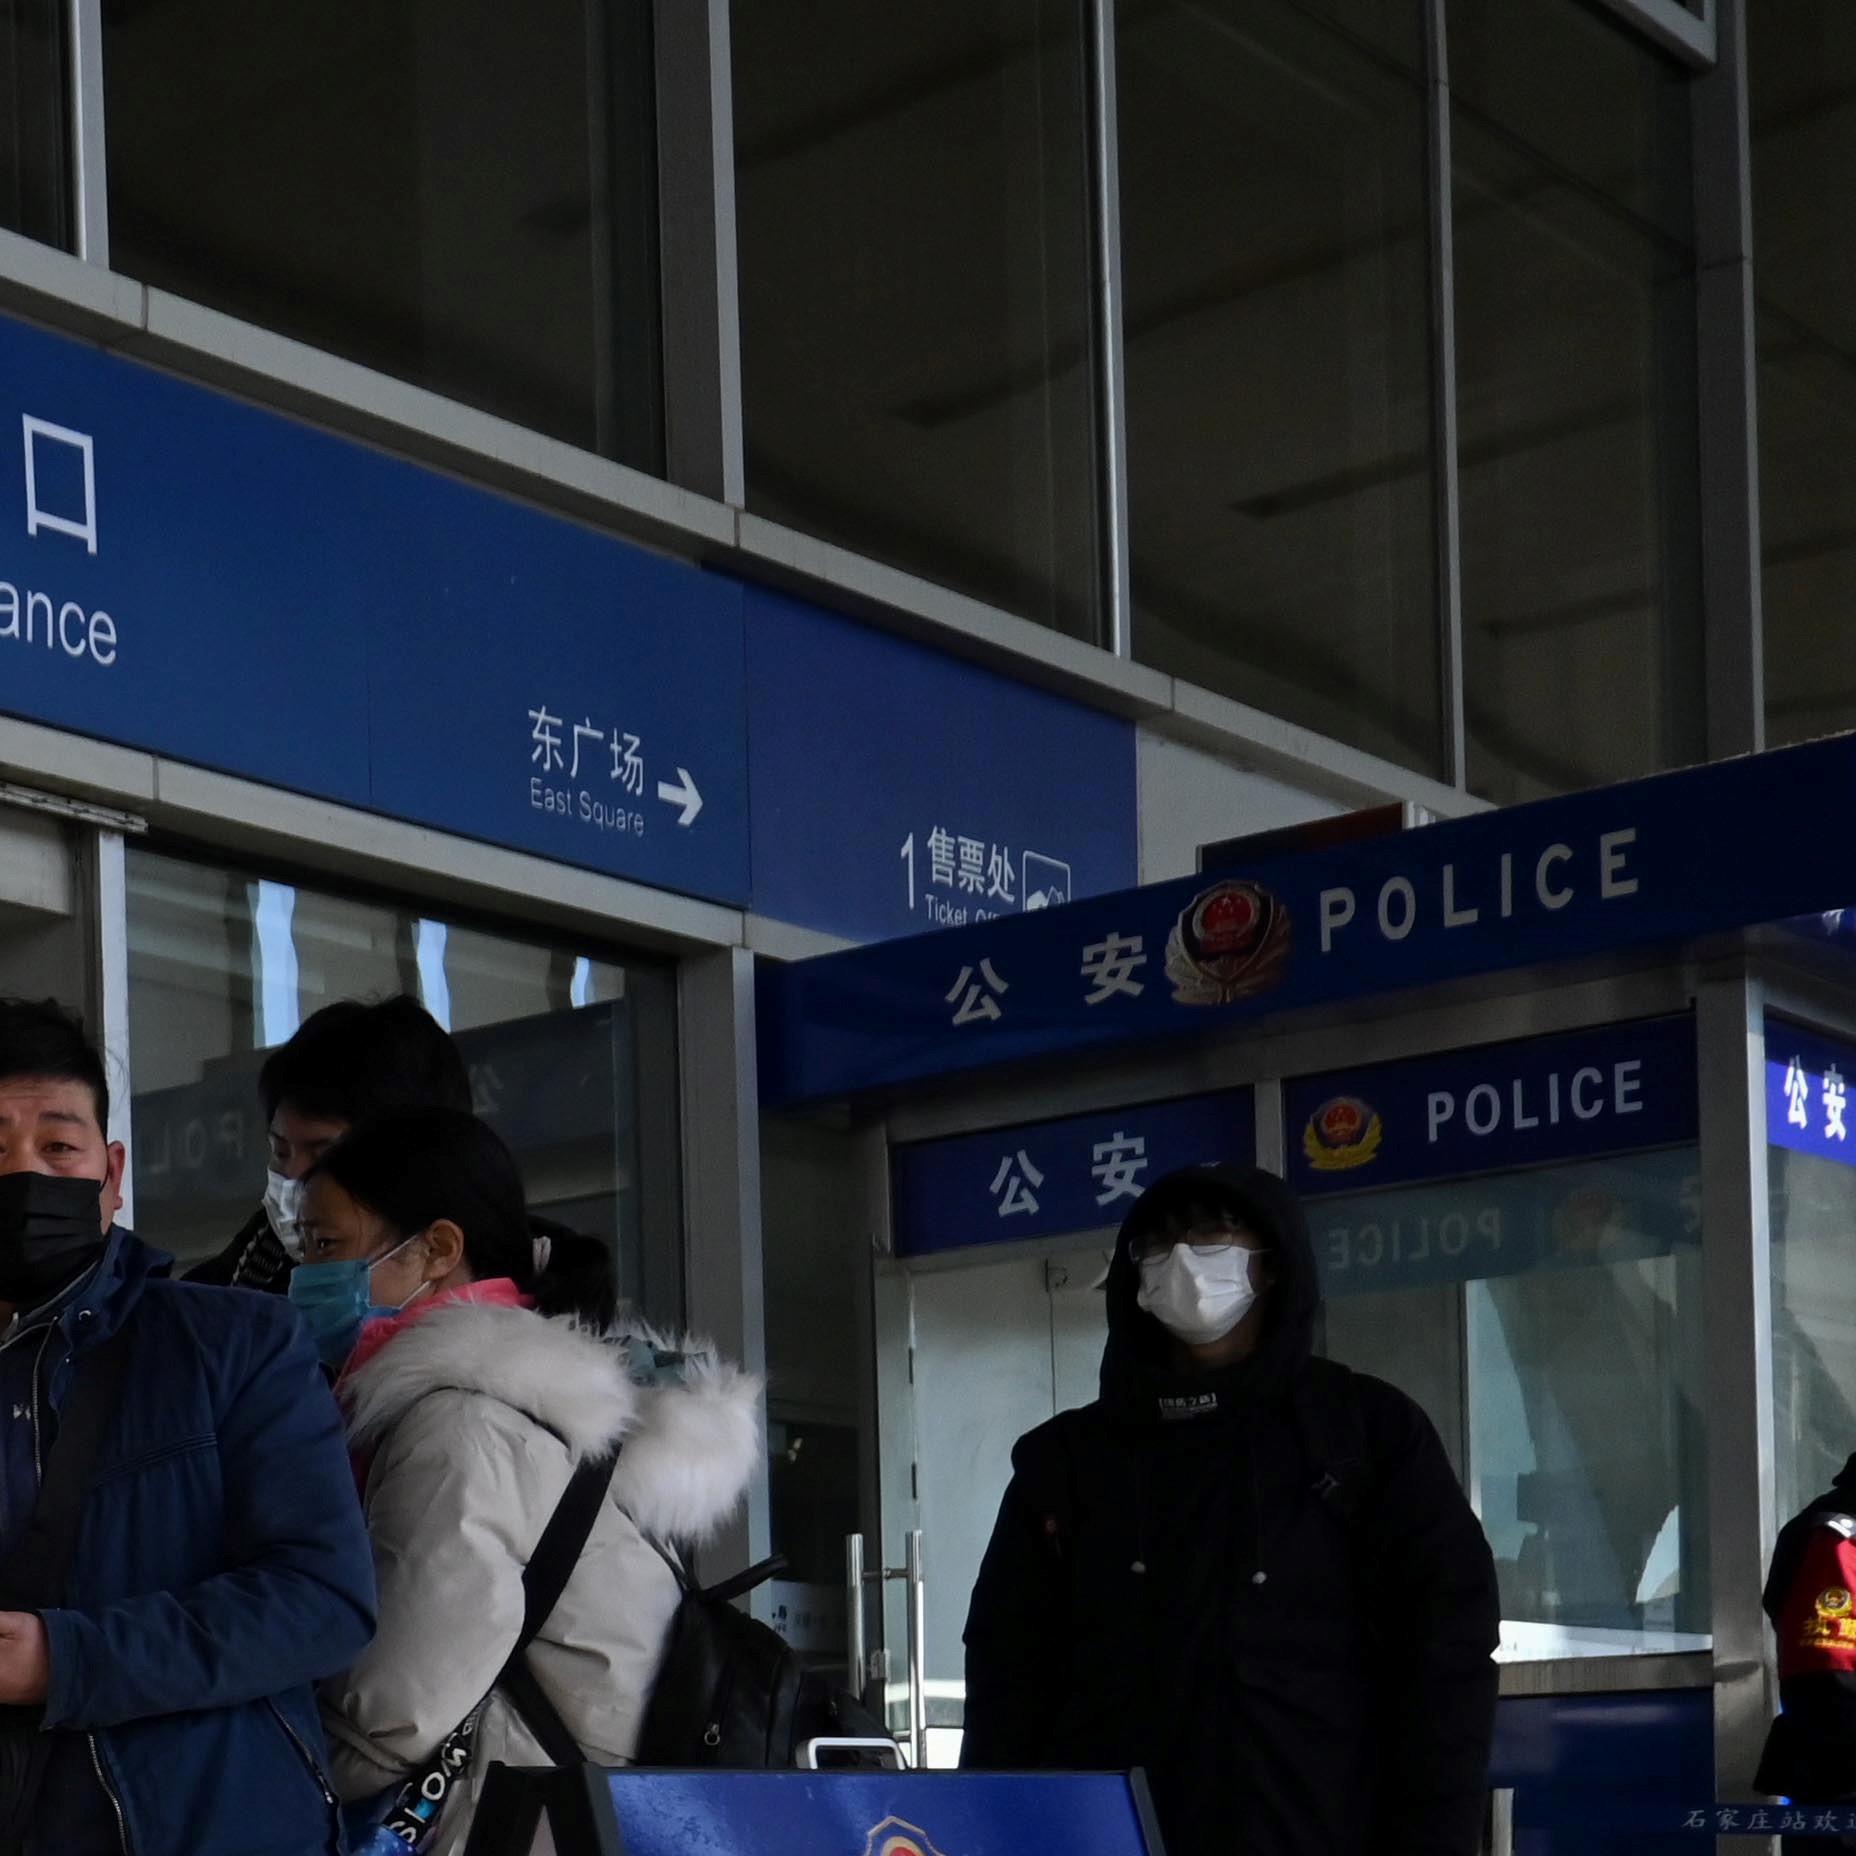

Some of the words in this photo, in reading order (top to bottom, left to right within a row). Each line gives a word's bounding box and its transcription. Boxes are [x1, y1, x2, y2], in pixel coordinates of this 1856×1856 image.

[528, 705, 644, 797] 东广场
[530, 777, 572, 818] East
[579, 794, 644, 837] Square
[926, 825, 1015, 904] 售票处
[1319, 827, 1641, 953] POLICE
[925, 893, 968, 926] Ticket
[945, 931, 1148, 1027] 公安
[1427, 1059, 1644, 1143] POLICE
[1784, 1054, 1847, 1142] 公安
[990, 1130, 1149, 1218] 公安
